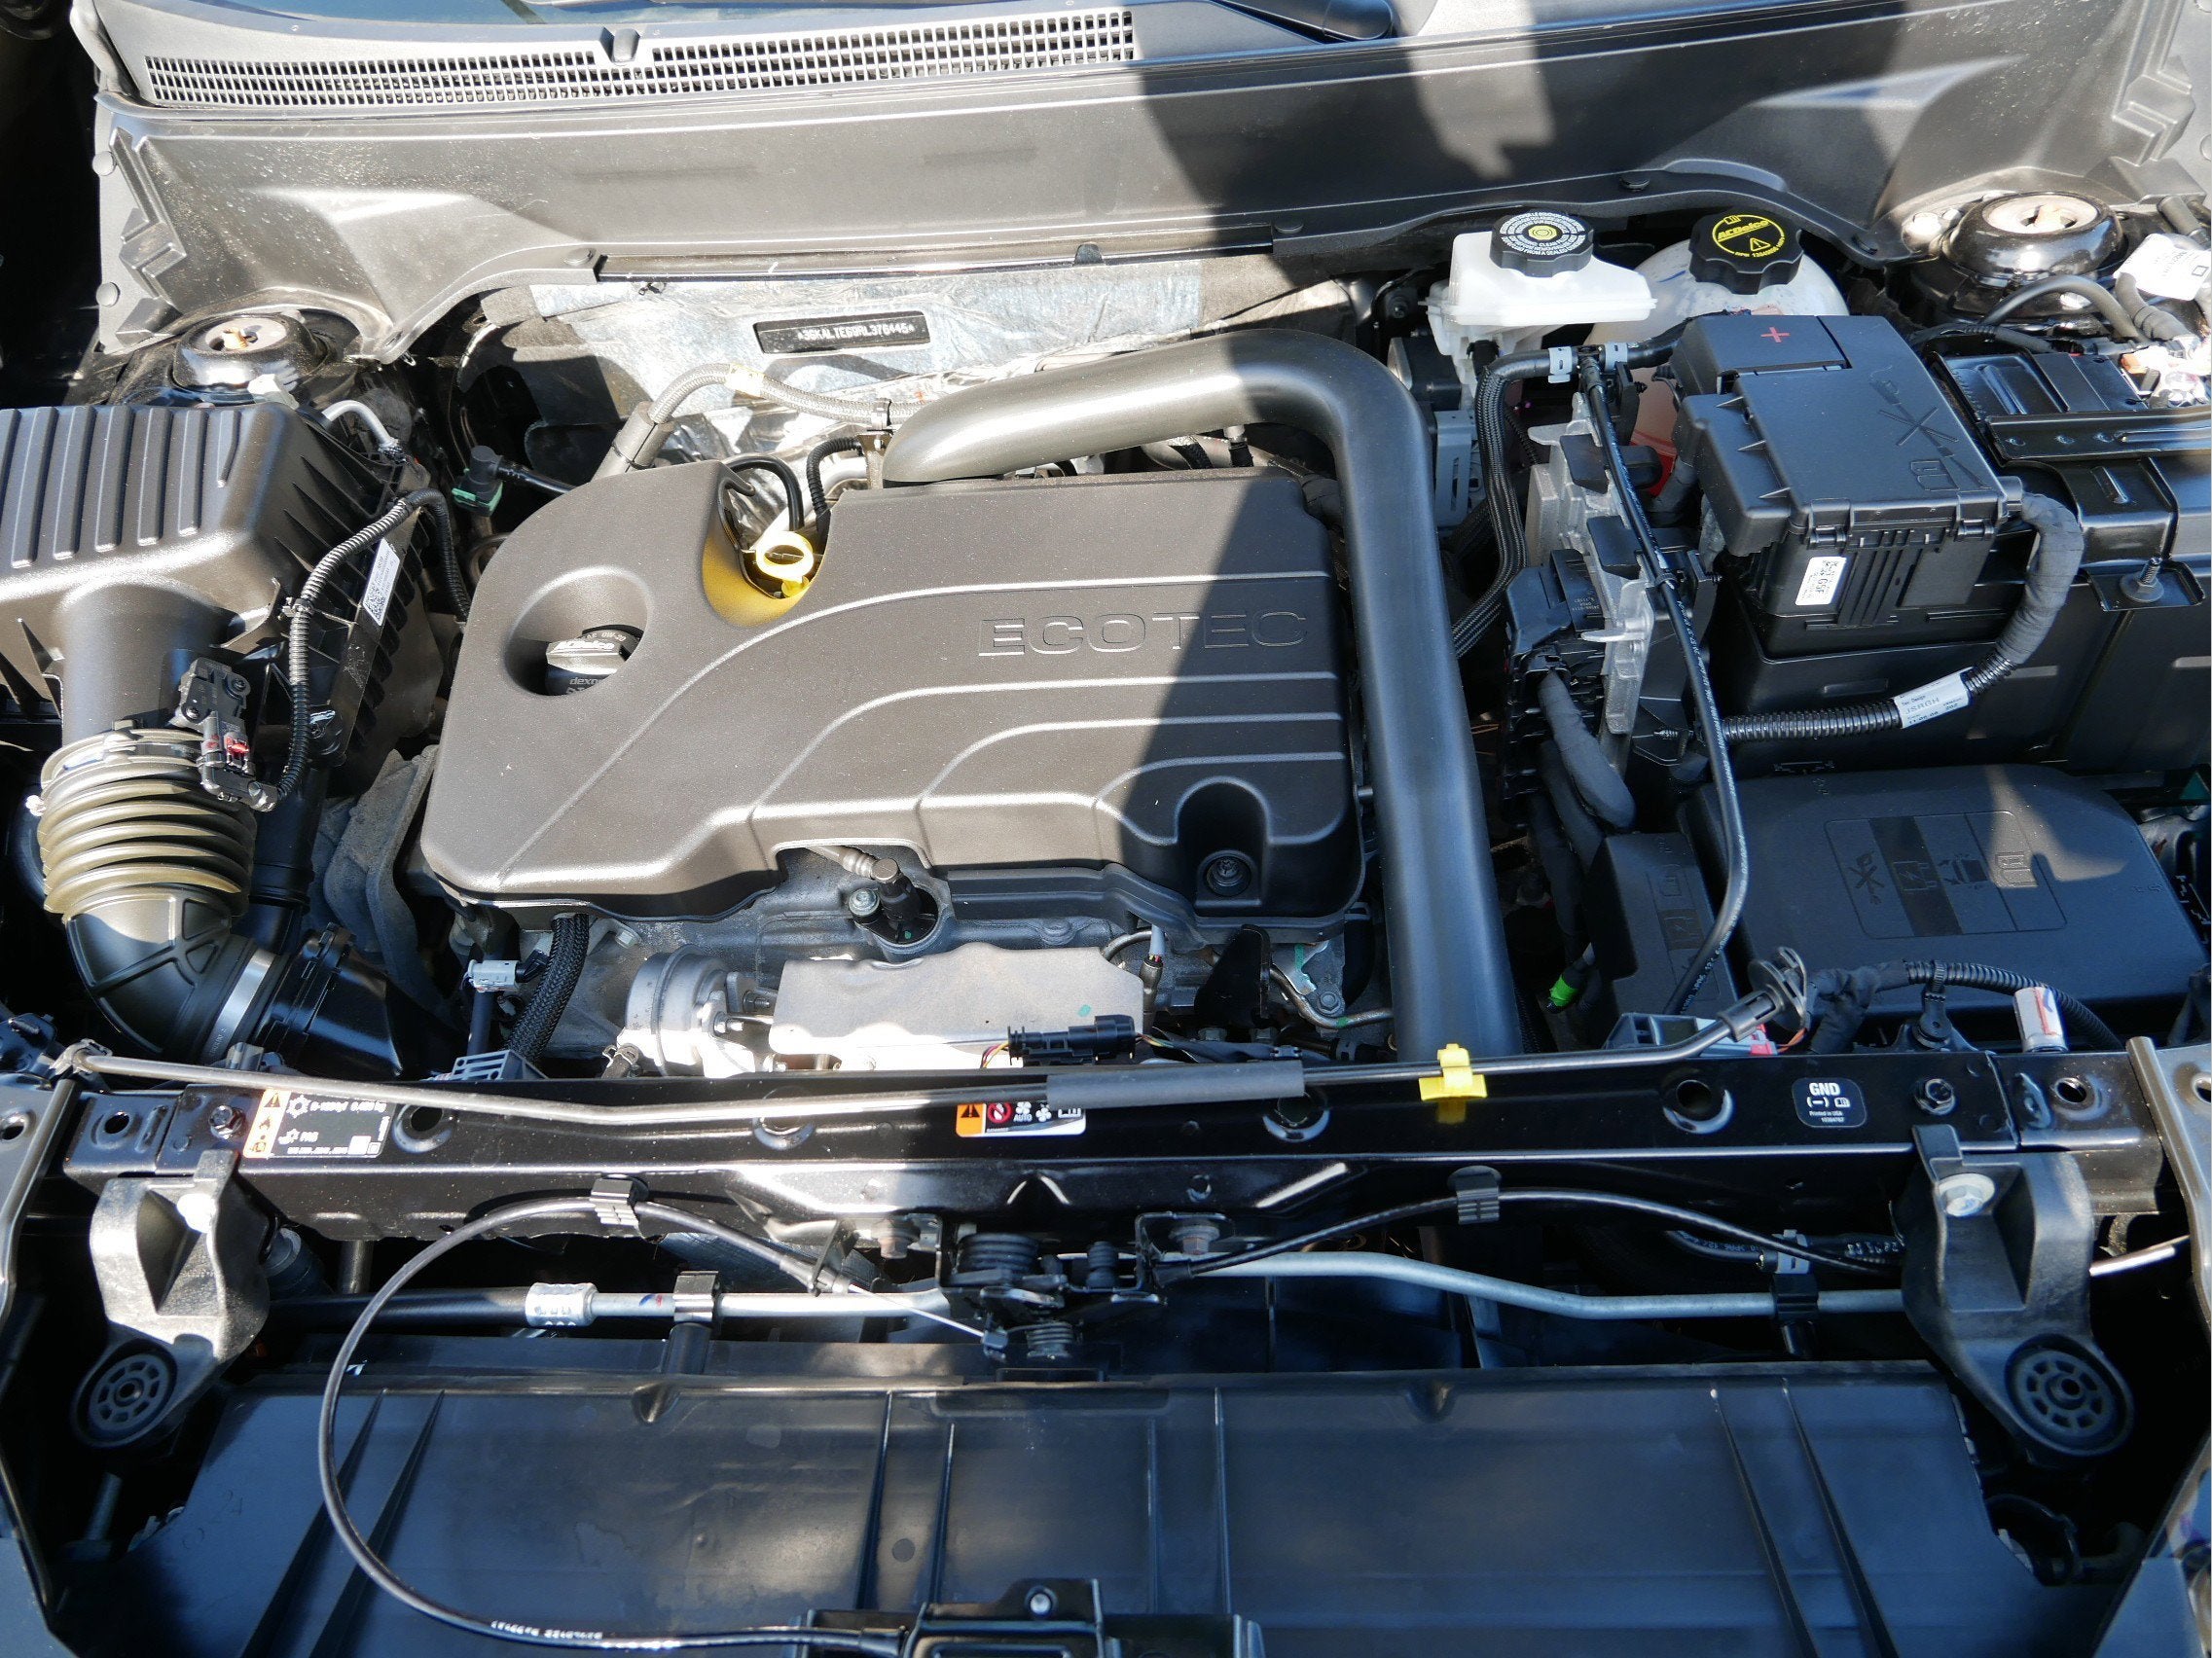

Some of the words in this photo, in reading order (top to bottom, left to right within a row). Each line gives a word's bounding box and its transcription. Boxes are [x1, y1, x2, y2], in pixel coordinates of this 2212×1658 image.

[1718, 220, 1770, 240] ACDelco
[978, 611, 1308, 657] ECOTEC
[569, 676, 601, 685] dexo
[1808, 1082, 1841, 1097] GND
[1013, 1113, 1033, 1123] AUTO
